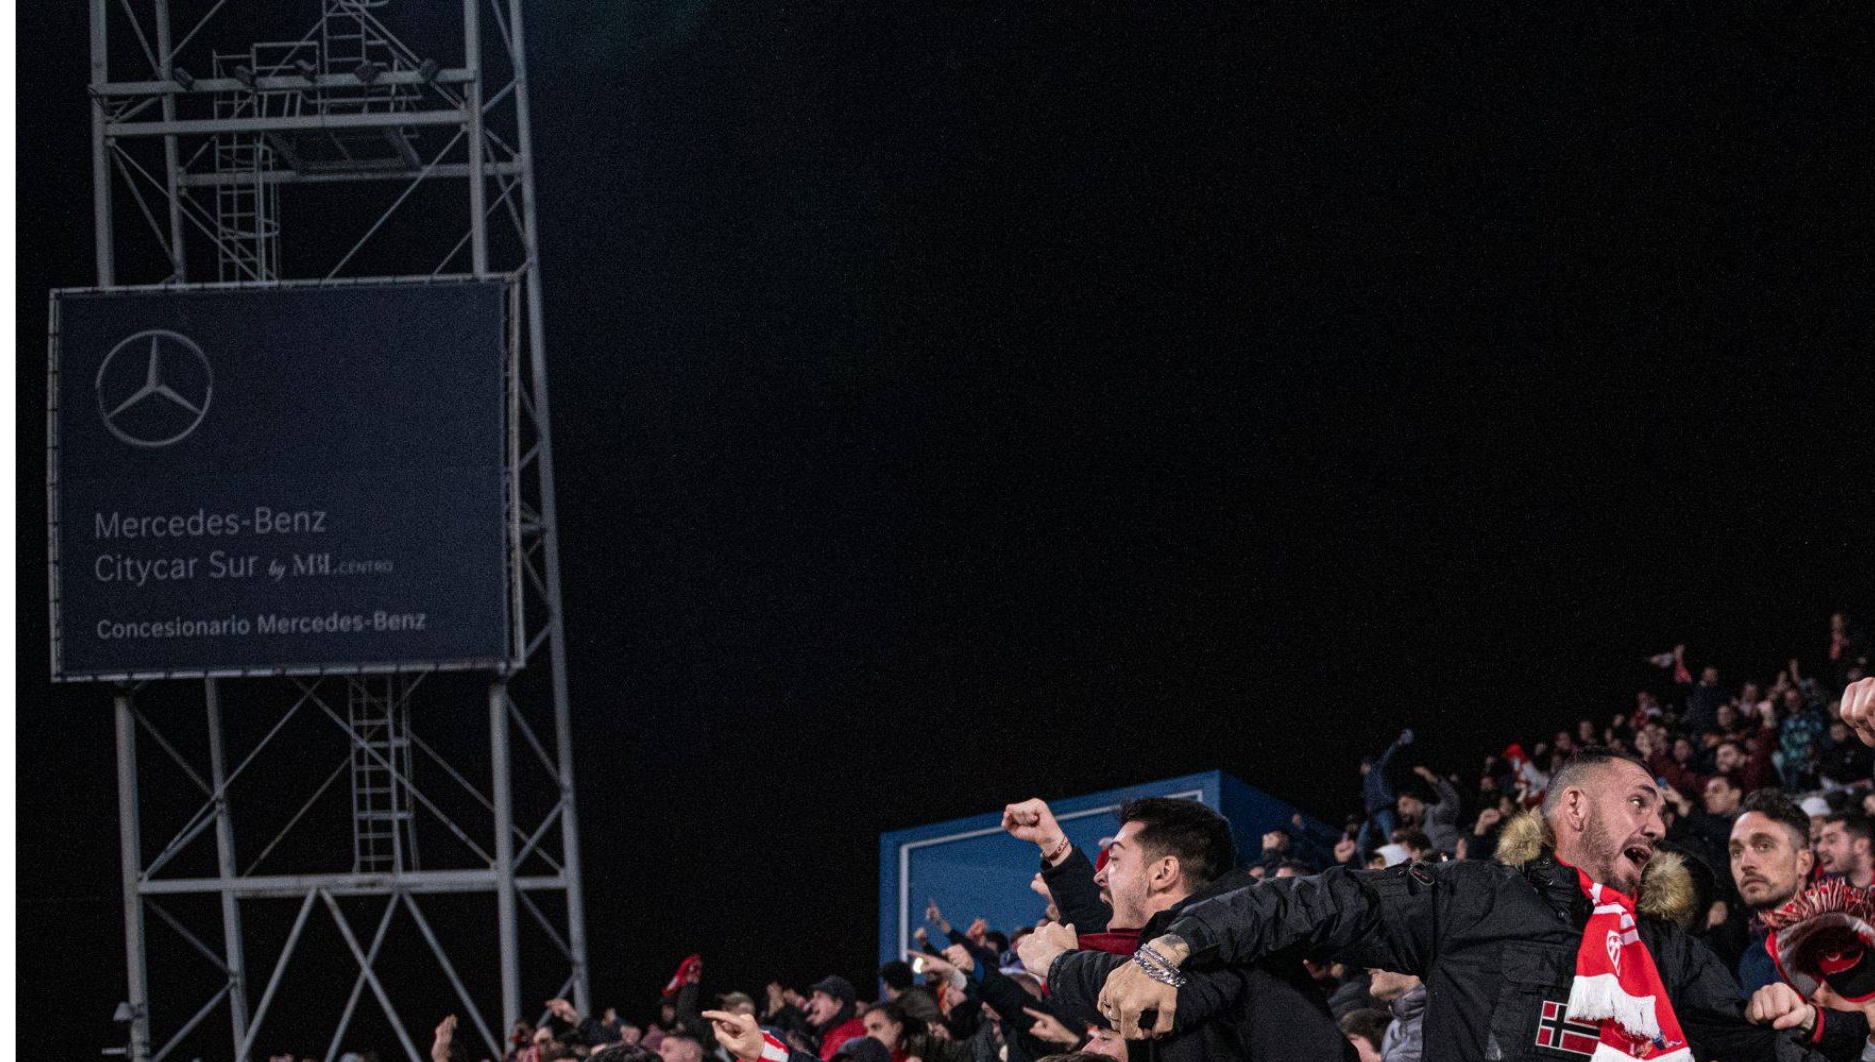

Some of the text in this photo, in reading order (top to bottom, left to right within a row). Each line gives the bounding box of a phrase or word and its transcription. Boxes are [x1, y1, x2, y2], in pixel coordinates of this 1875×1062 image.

[94, 506, 326, 541] Mercedes-Benz
[94, 552, 198, 587] Citycar
[208, 549, 258, 579] Sur
[268, 559, 286, 582] by
[96, 611, 426, 641] Concesionario Mercedes-Benz
